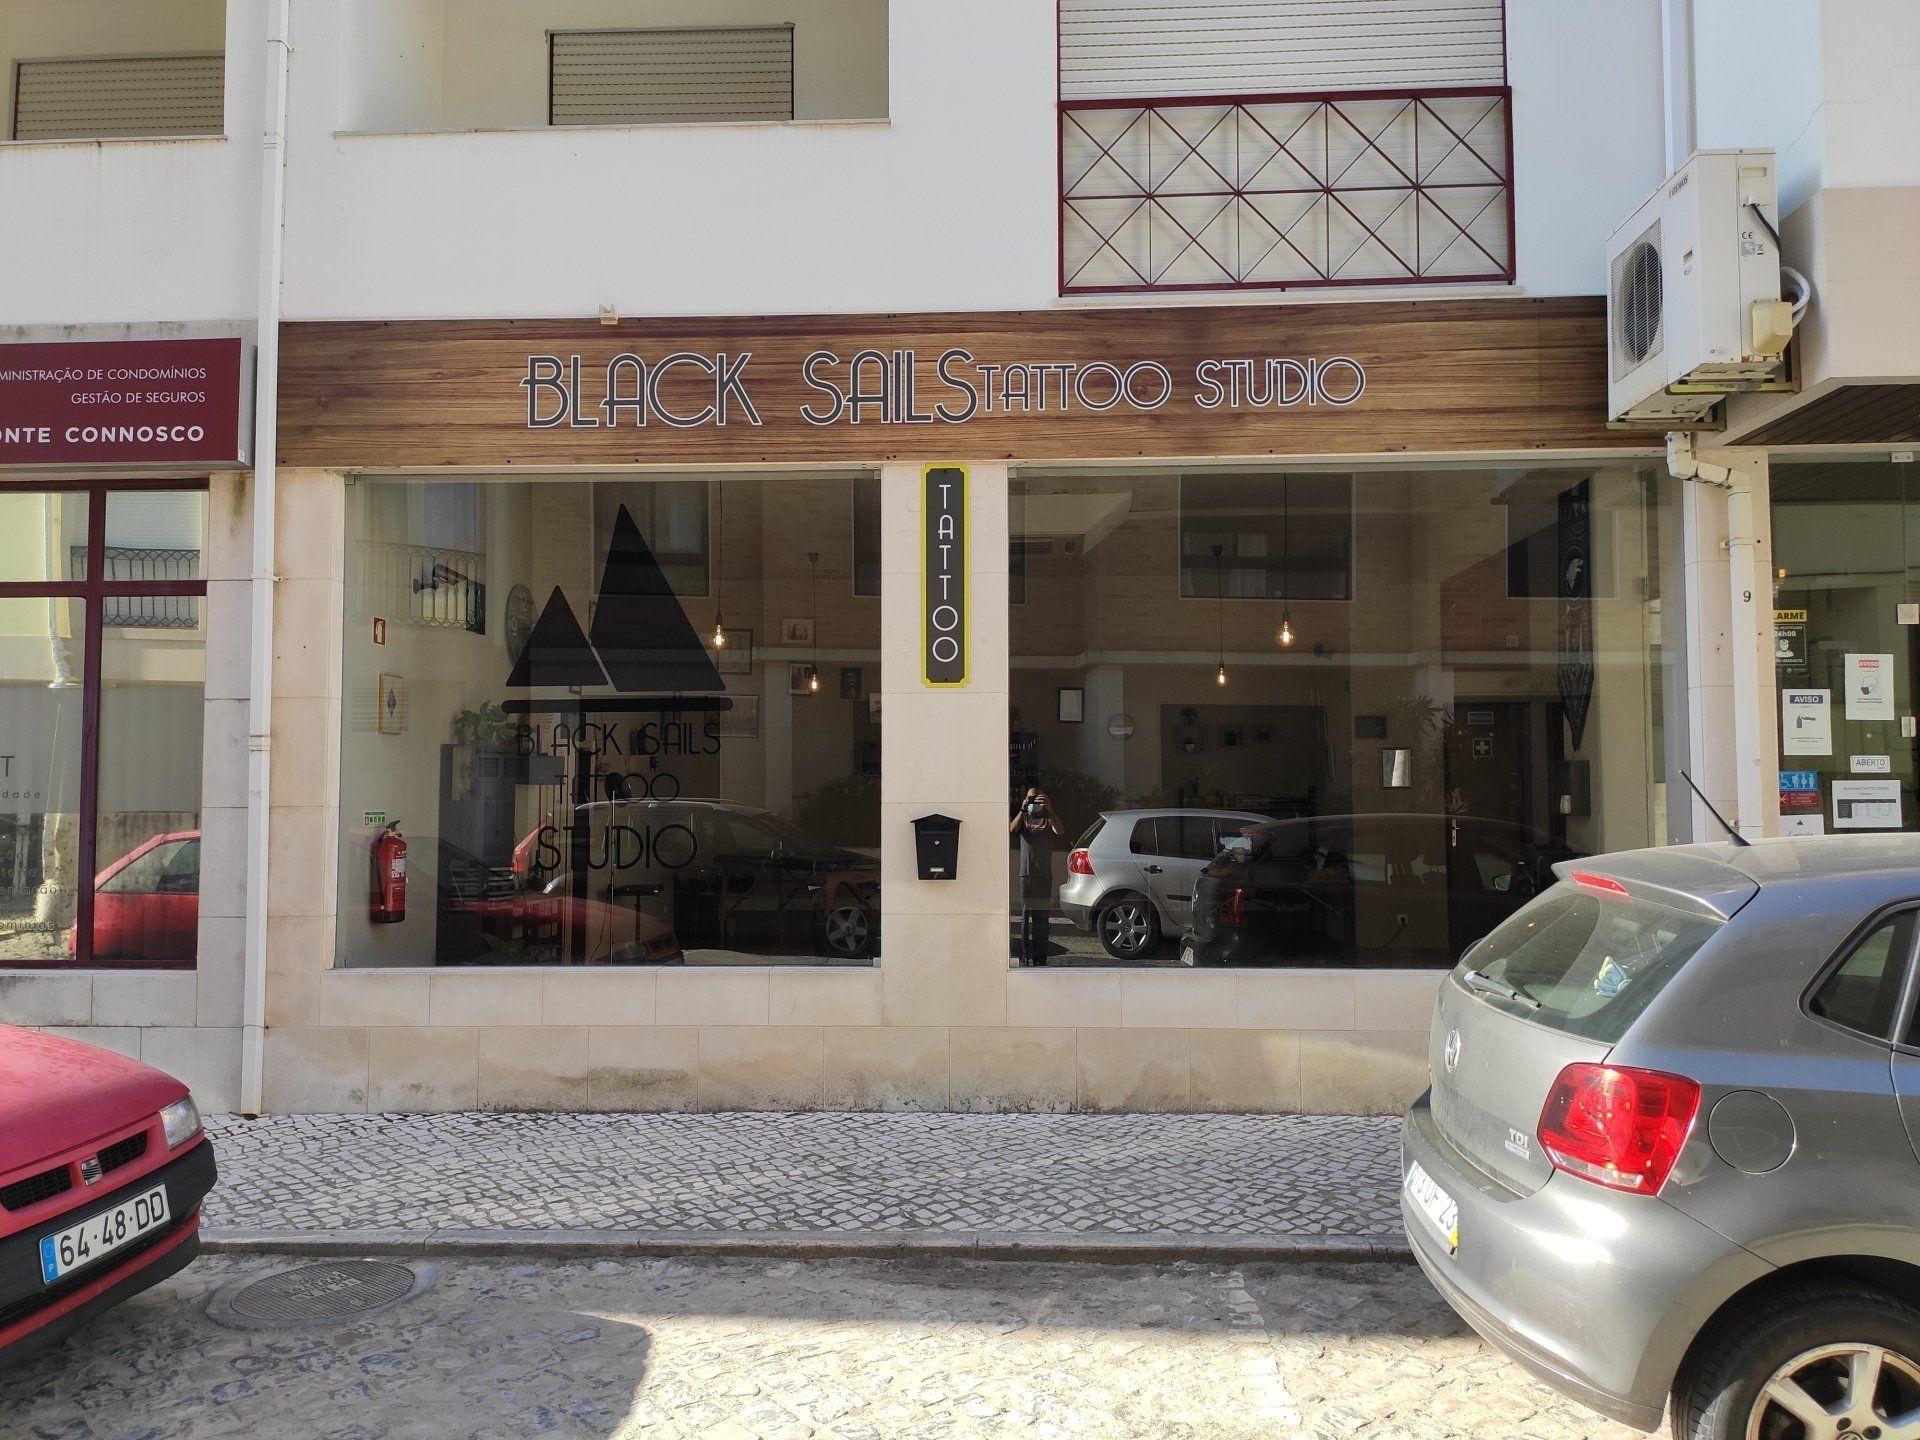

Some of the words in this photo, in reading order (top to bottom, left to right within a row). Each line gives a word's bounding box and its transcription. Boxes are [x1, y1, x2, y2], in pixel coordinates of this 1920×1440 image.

[0, 367, 83, 383] MINISTRAÇÃO
[87, 369, 104, 380] DE
[107, 365, 206, 380] CONDOMÍNIOS
[71, 390, 122, 404] GESTÃO
[126, 392, 142, 403] DE
[146, 391, 206, 403] SEGUROS
[519, 353, 762, 427] BLACK
[800, 349, 979, 426] SAILS
[976, 361, 1172, 411] TATTOO
[1194, 356, 1366, 409] STUDIO
[0, 427, 51, 443] NTE
[65, 425, 204, 443] CONNOSCO
[932, 484, 959, 663] TATTOO
[1743, 590, 1752, 603] 9
[1794, 695, 1819, 703] AVISO
[516, 723, 623, 756] BLACK
[643, 722, 721, 755] SAILS
[1856, 759, 1886, 767] ABERTO
[554, 773, 680, 804] TTOO
[1508, 1128, 1529, 1148] TDI
[48, 1263, 54, 1273] P
